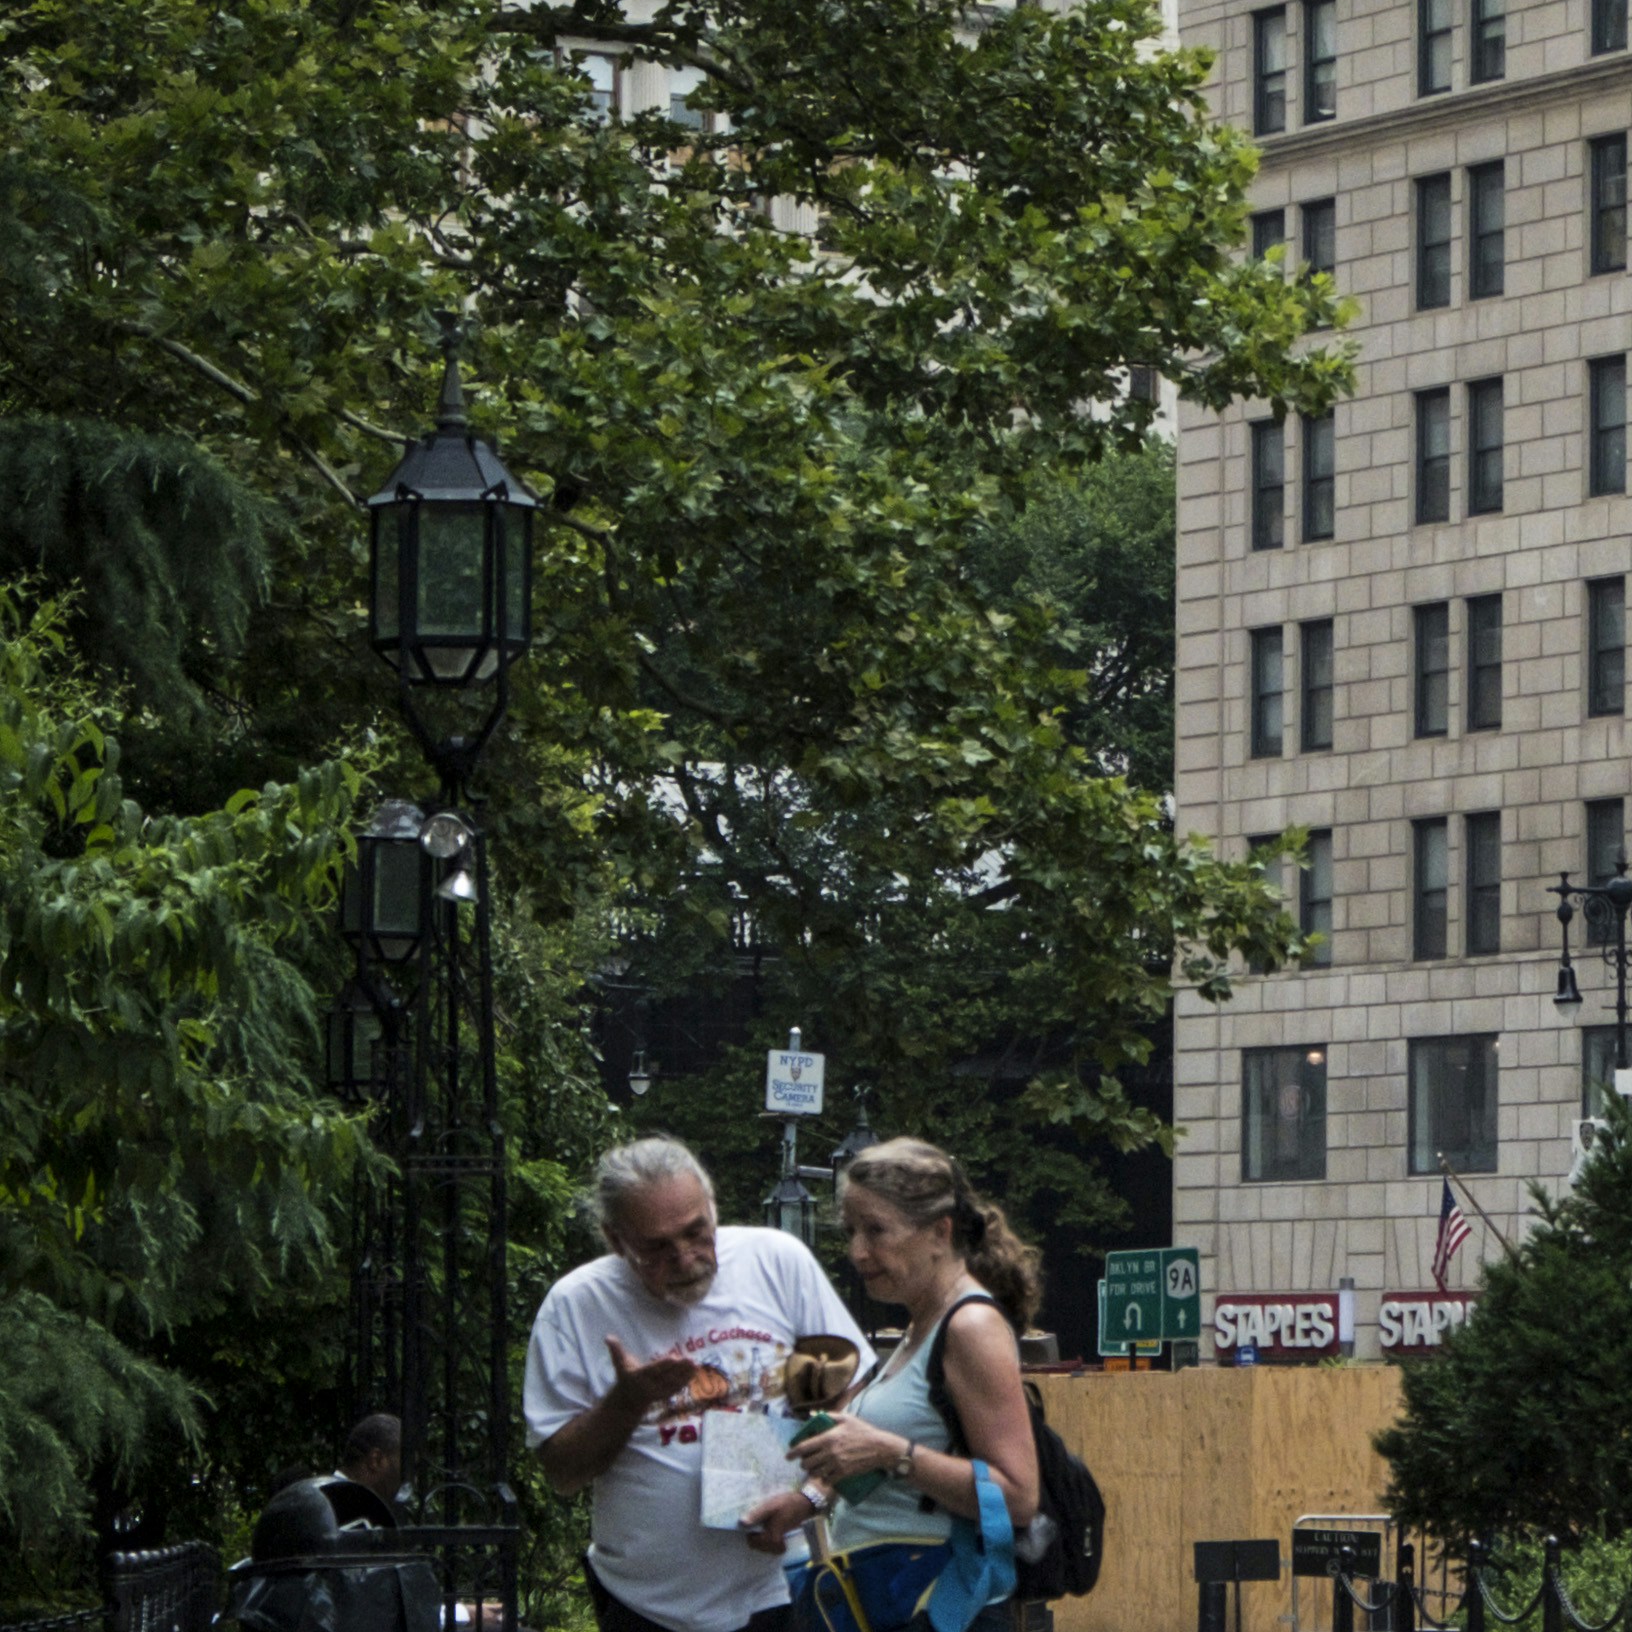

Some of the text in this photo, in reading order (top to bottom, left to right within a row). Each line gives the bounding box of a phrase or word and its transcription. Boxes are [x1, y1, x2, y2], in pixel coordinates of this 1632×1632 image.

[780, 1055, 813, 1068] NYPD
[772, 1079, 818, 1094] SECURITY
[774, 1091, 815, 1103] CAMERA
[1109, 1261, 1139, 1275] BKLYN
[1169, 1267, 1193, 1291] 9A
[1130, 1281, 1156, 1295] DRIVE
[1214, 1303, 1335, 1349] STAPLES
[1379, 1301, 1478, 1348] STAPL
